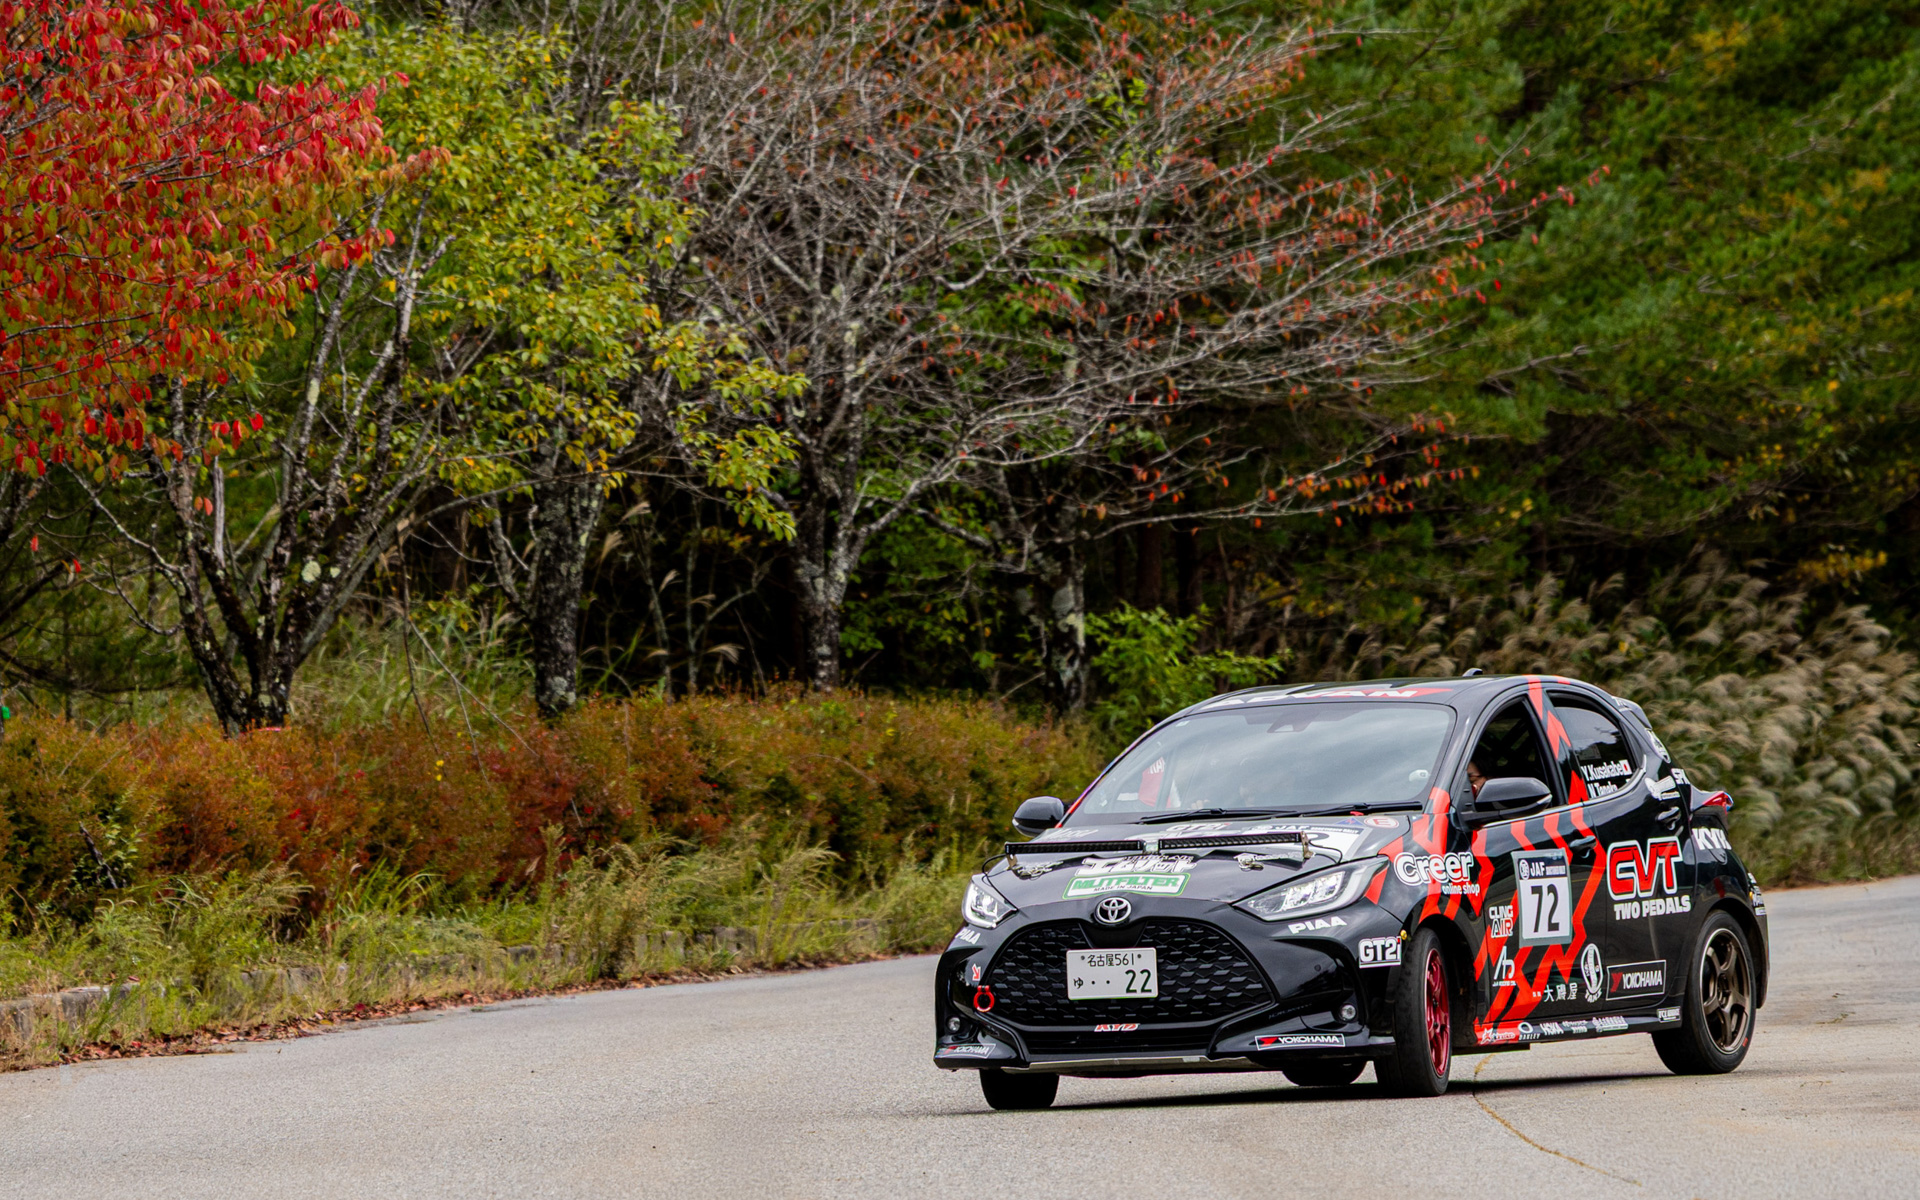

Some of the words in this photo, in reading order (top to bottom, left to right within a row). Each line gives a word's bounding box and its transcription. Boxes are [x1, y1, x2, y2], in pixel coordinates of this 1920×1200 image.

[1394, 852, 1474, 886] Creer
[1530, 862, 1545, 877] JAF
[1607, 836, 1684, 900] CVT
[1463, 882, 1480, 896] shop
[1489, 905, 1513, 919] CLING
[1531, 884, 1560, 932] 72
[1614, 901, 1640, 920] TWO
[1642, 895, 1691, 917] PEDALS
[1288, 916, 1347, 934] PIAA
[1491, 918, 1513, 938] AIR
[955, 928, 980, 944] PIAA
[1359, 936, 1401, 963] GT2i
[1125, 969, 1152, 994] 22
[1622, 970, 1663, 989] YOKOHAMA
[1278, 1035, 1340, 1045] YOKOHAMA
